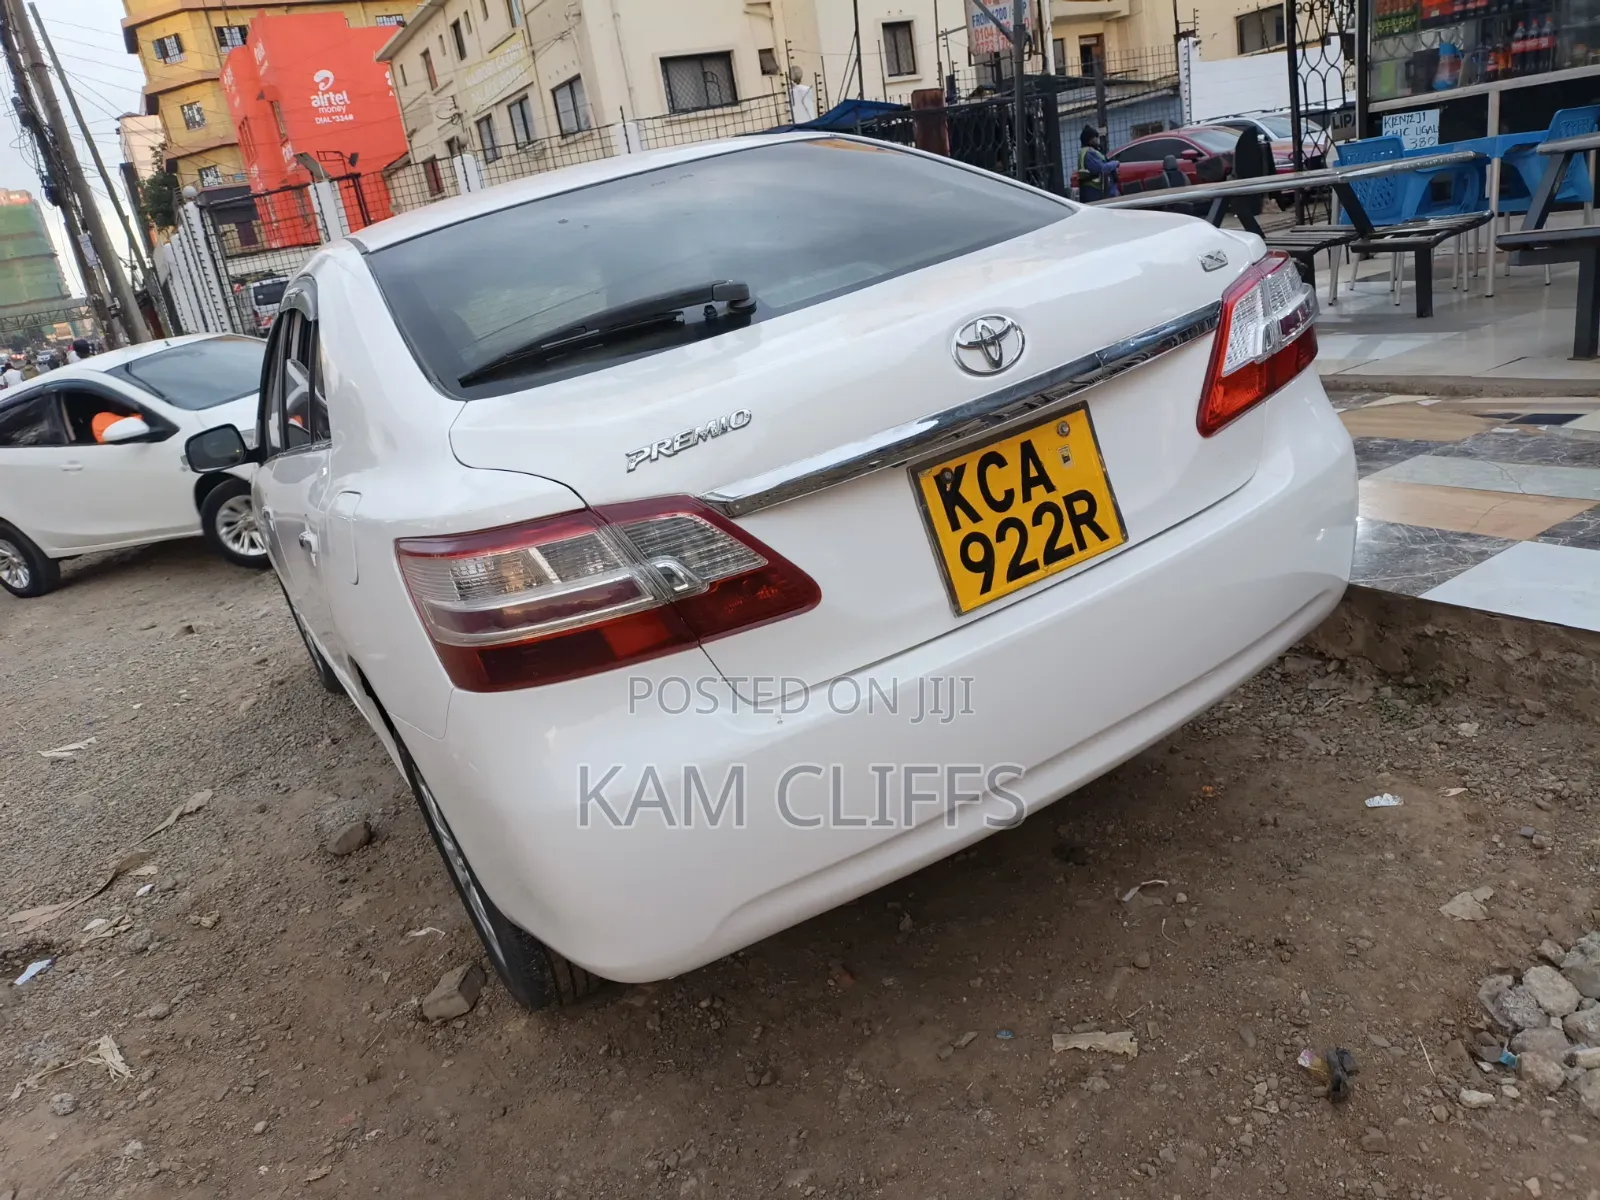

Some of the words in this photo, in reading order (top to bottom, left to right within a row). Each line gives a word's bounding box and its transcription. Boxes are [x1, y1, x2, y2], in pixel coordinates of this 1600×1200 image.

[310, 90, 351, 108] airtel
[319, 105, 347, 114] money
[315, 116, 333, 125] DIAL
[1409, 136, 1437, 149] 380
[625, 408, 752, 474] PREMIO
[933, 439, 1057, 532] KCA
[959, 489, 1110, 596] 922R
